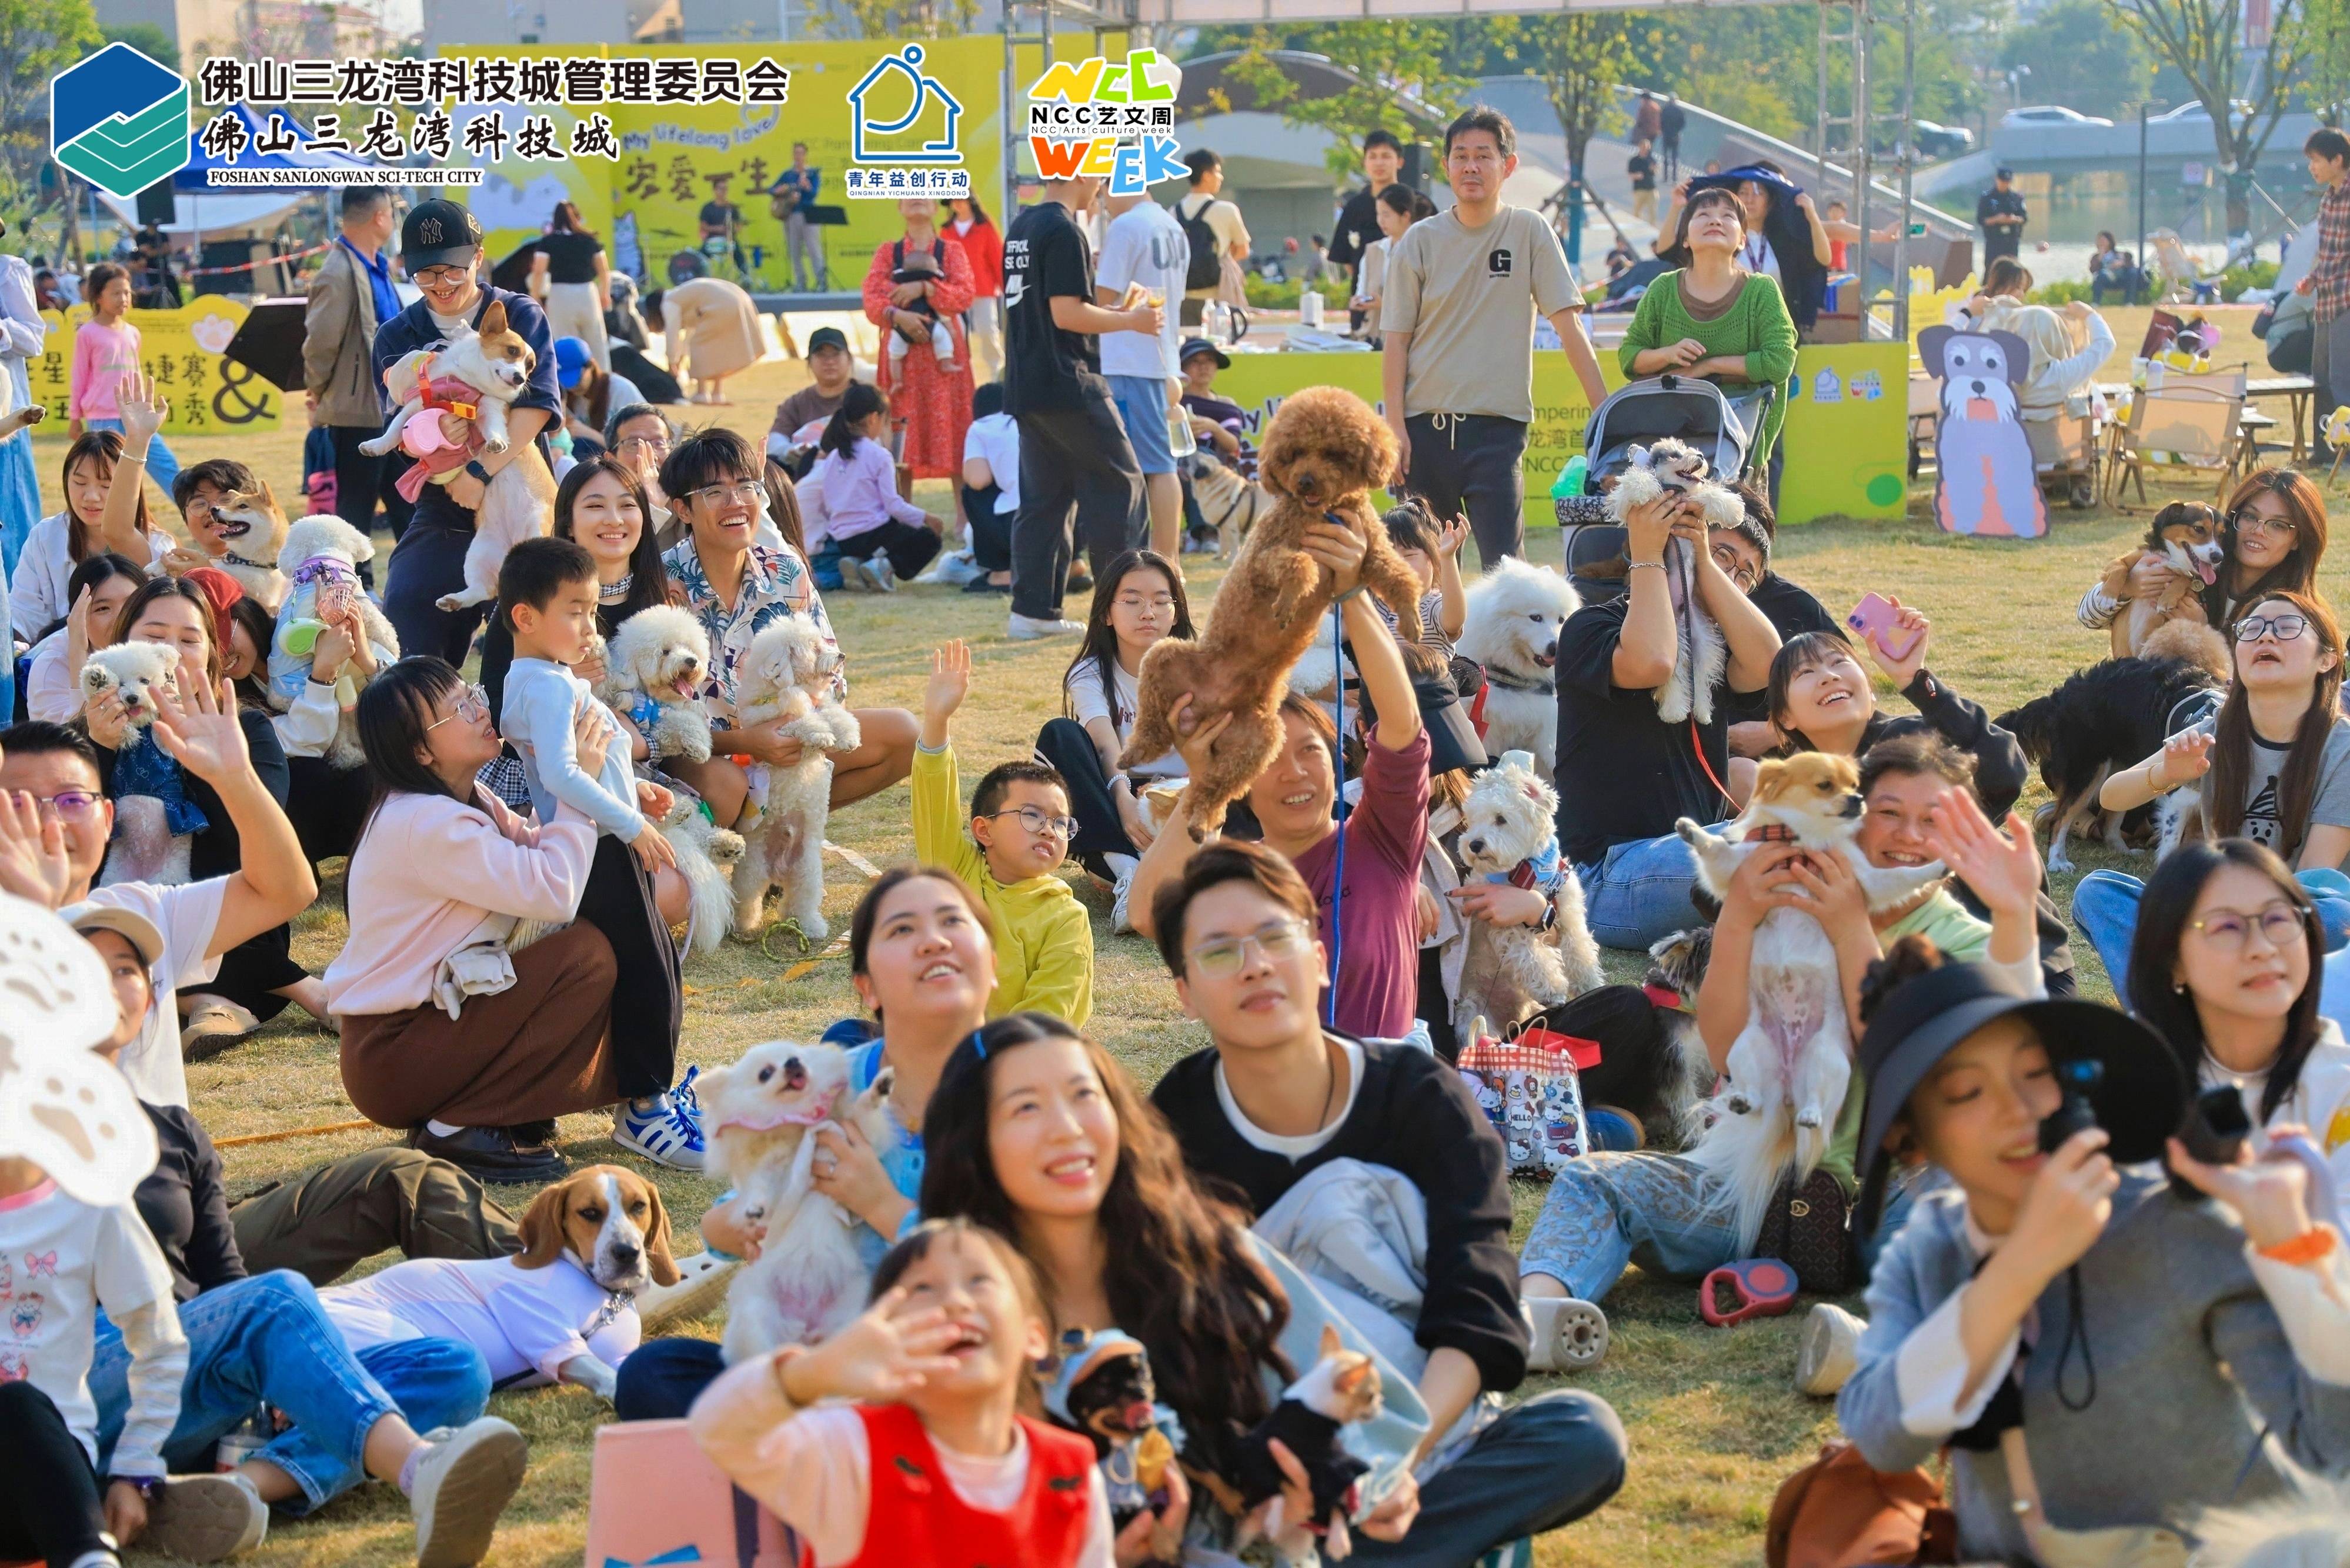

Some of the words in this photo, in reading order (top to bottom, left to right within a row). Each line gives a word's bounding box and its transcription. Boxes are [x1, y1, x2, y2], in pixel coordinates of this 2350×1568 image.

[1489, 249, 1511, 272] G
[1534, 403, 1591, 422] mperin
[1528, 429, 1585, 449] 龙湾首
